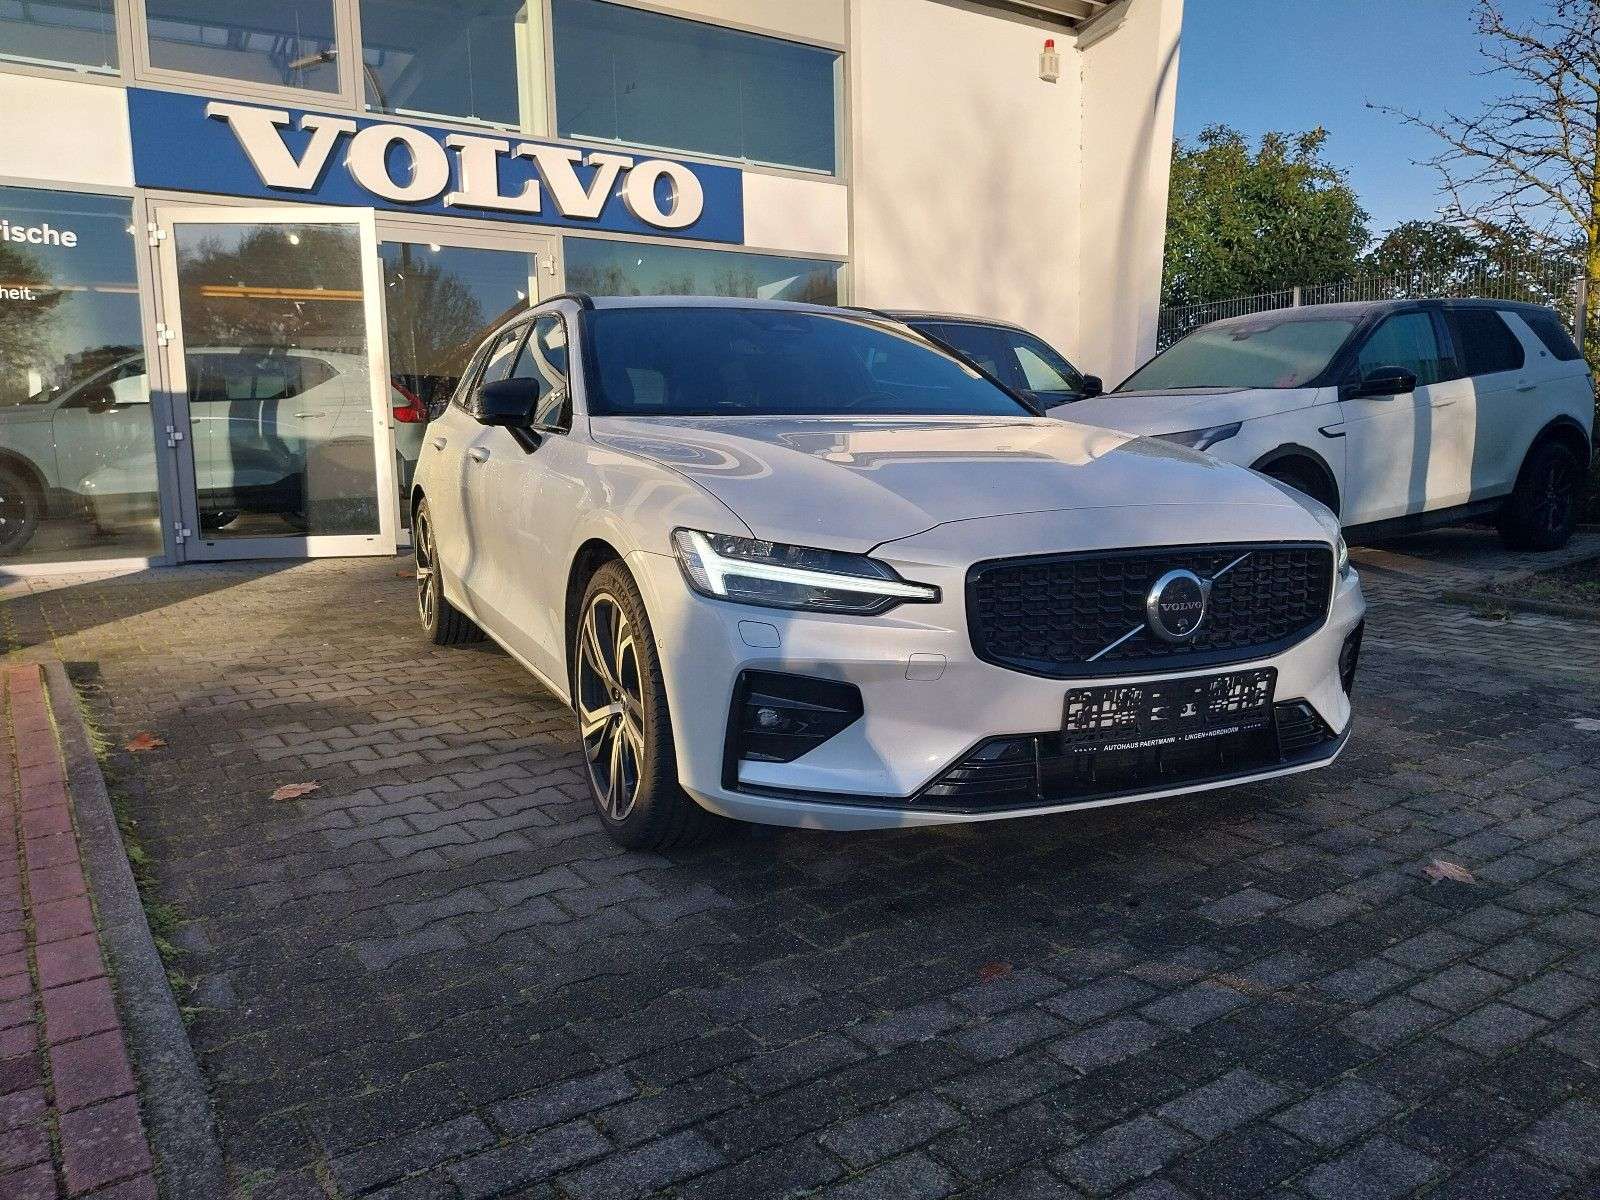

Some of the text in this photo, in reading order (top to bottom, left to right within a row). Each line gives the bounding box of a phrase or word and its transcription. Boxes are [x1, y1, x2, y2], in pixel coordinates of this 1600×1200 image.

[206, 102, 704, 228] VOLVO
[0, 220, 78, 247] ische
[1160, 601, 1203, 611] VOLVO
[1103, 741, 1139, 751] AUTOHAUS
[1139, 737, 1176, 748] PAERTMANN
